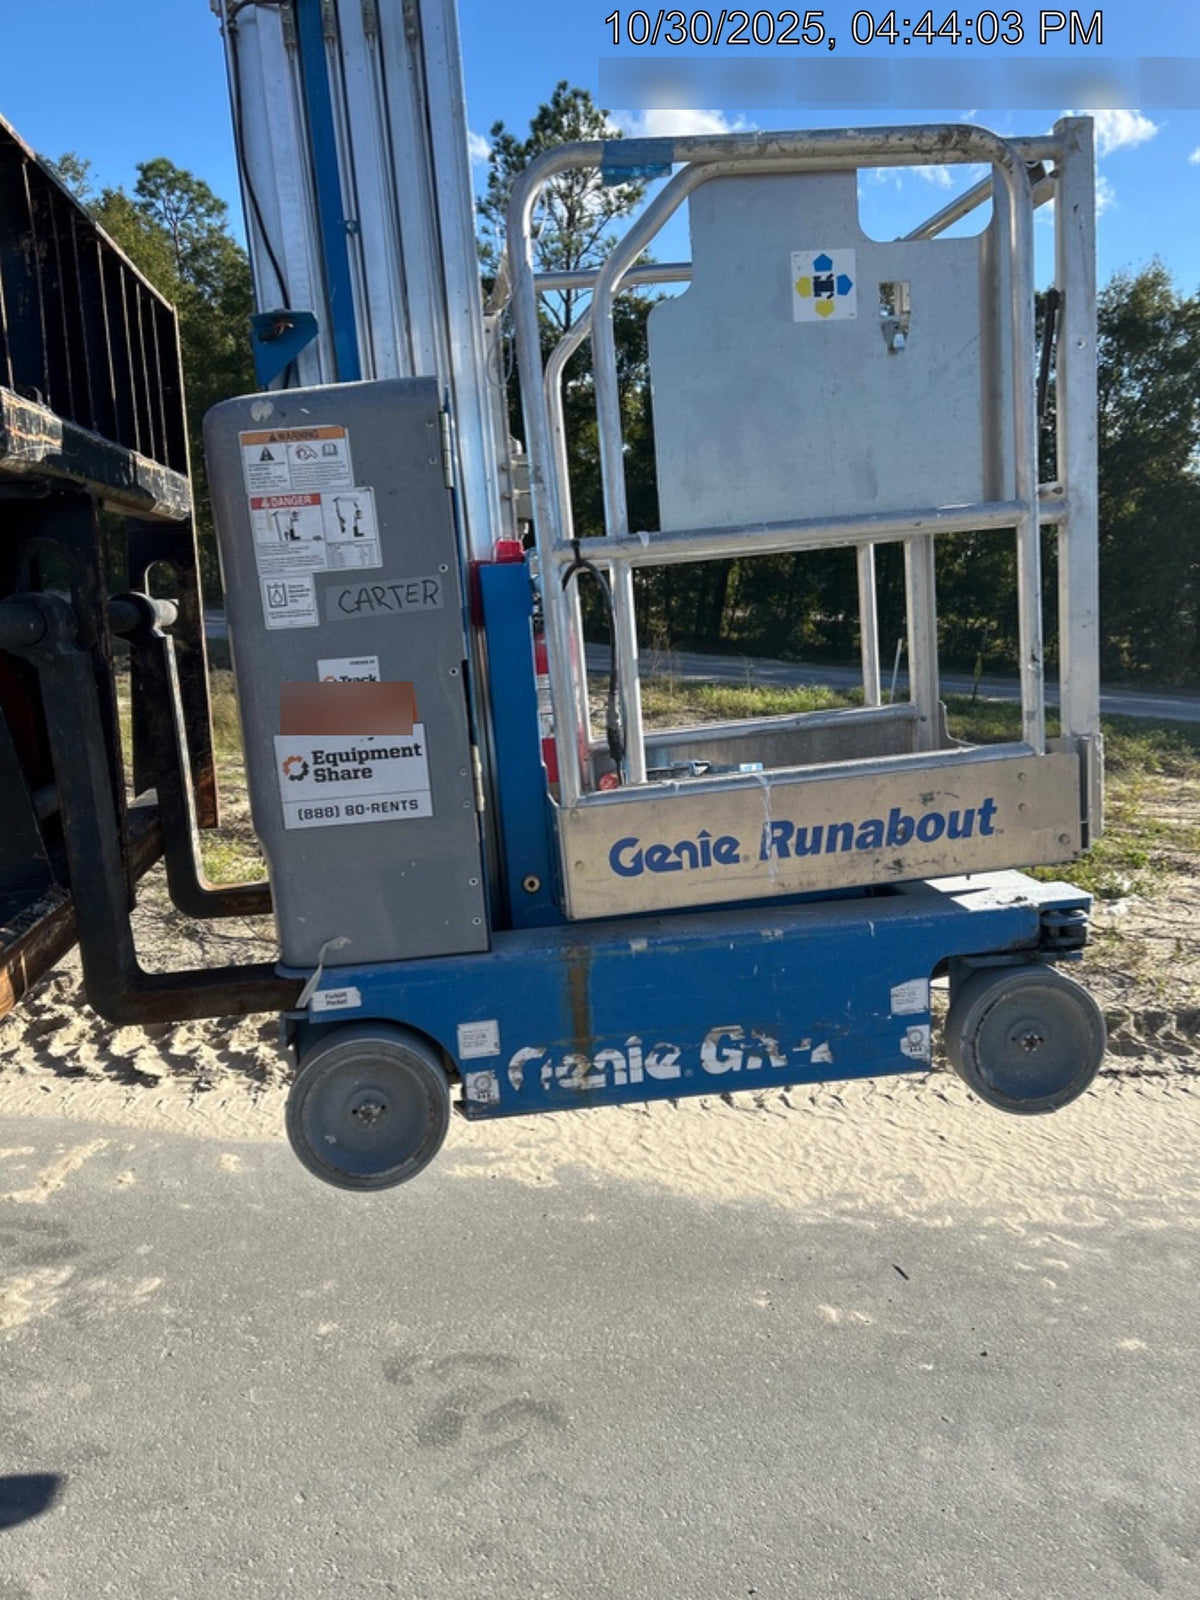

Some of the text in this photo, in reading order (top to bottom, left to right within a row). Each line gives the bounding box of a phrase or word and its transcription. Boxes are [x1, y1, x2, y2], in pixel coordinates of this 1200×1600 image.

[276, 429, 320, 441] WARNING
[271, 496, 312, 507] DANGER
[339, 579, 440, 614] CARTER
[311, 742, 422, 767] Equipment
[314, 766, 373, 783] Share
[298, 799, 420, 821] (888) 80-RENTS
[760, 797, 998, 861] Runabout
